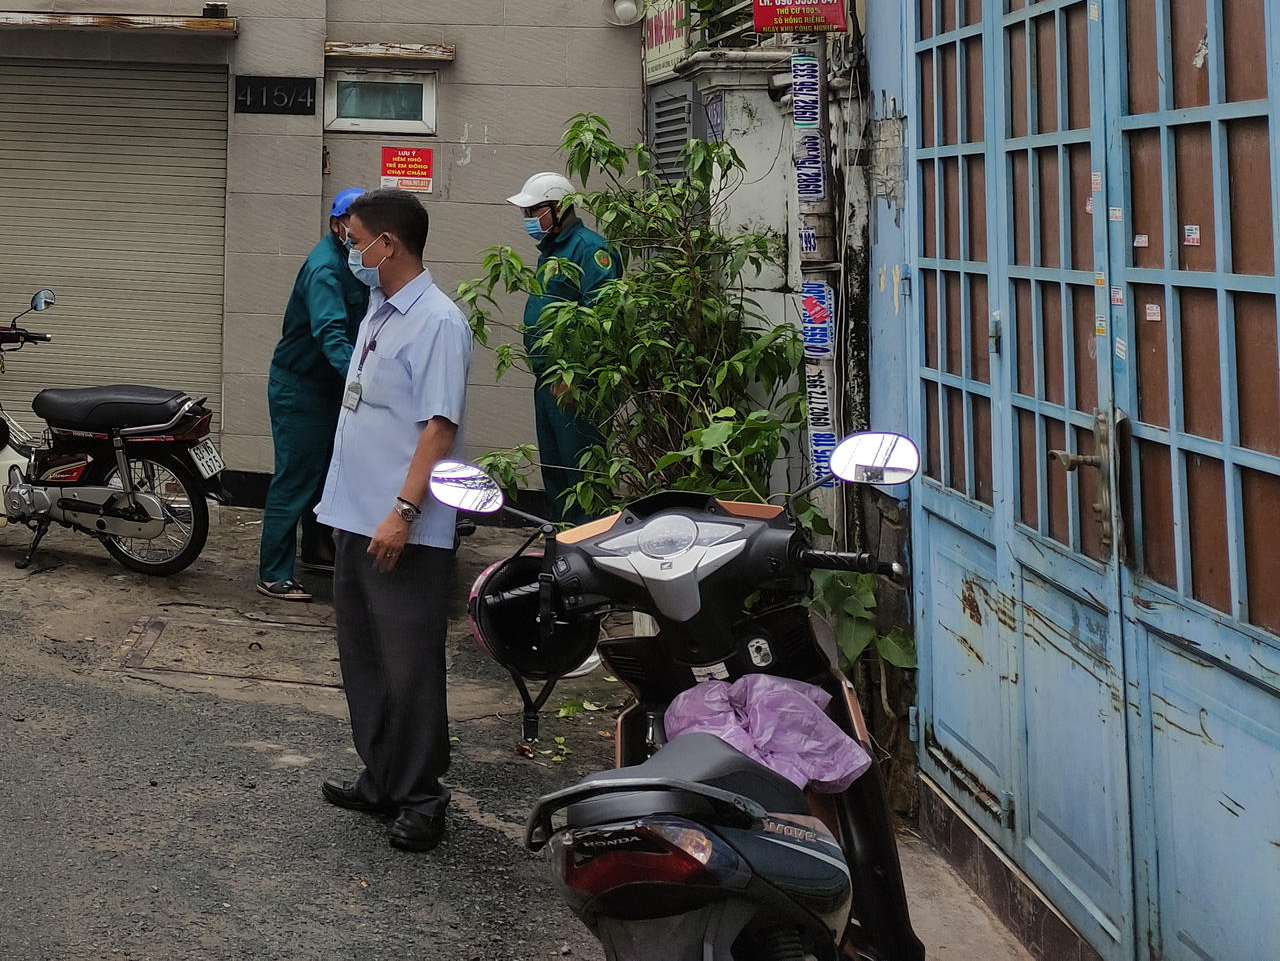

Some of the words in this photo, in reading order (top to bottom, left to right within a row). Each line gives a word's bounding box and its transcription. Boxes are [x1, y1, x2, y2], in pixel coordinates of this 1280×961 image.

[237, 84, 314, 108] 415/4
[793, 62, 819, 123] 0982.756.333
[583, 836, 641, 847] HONDA
